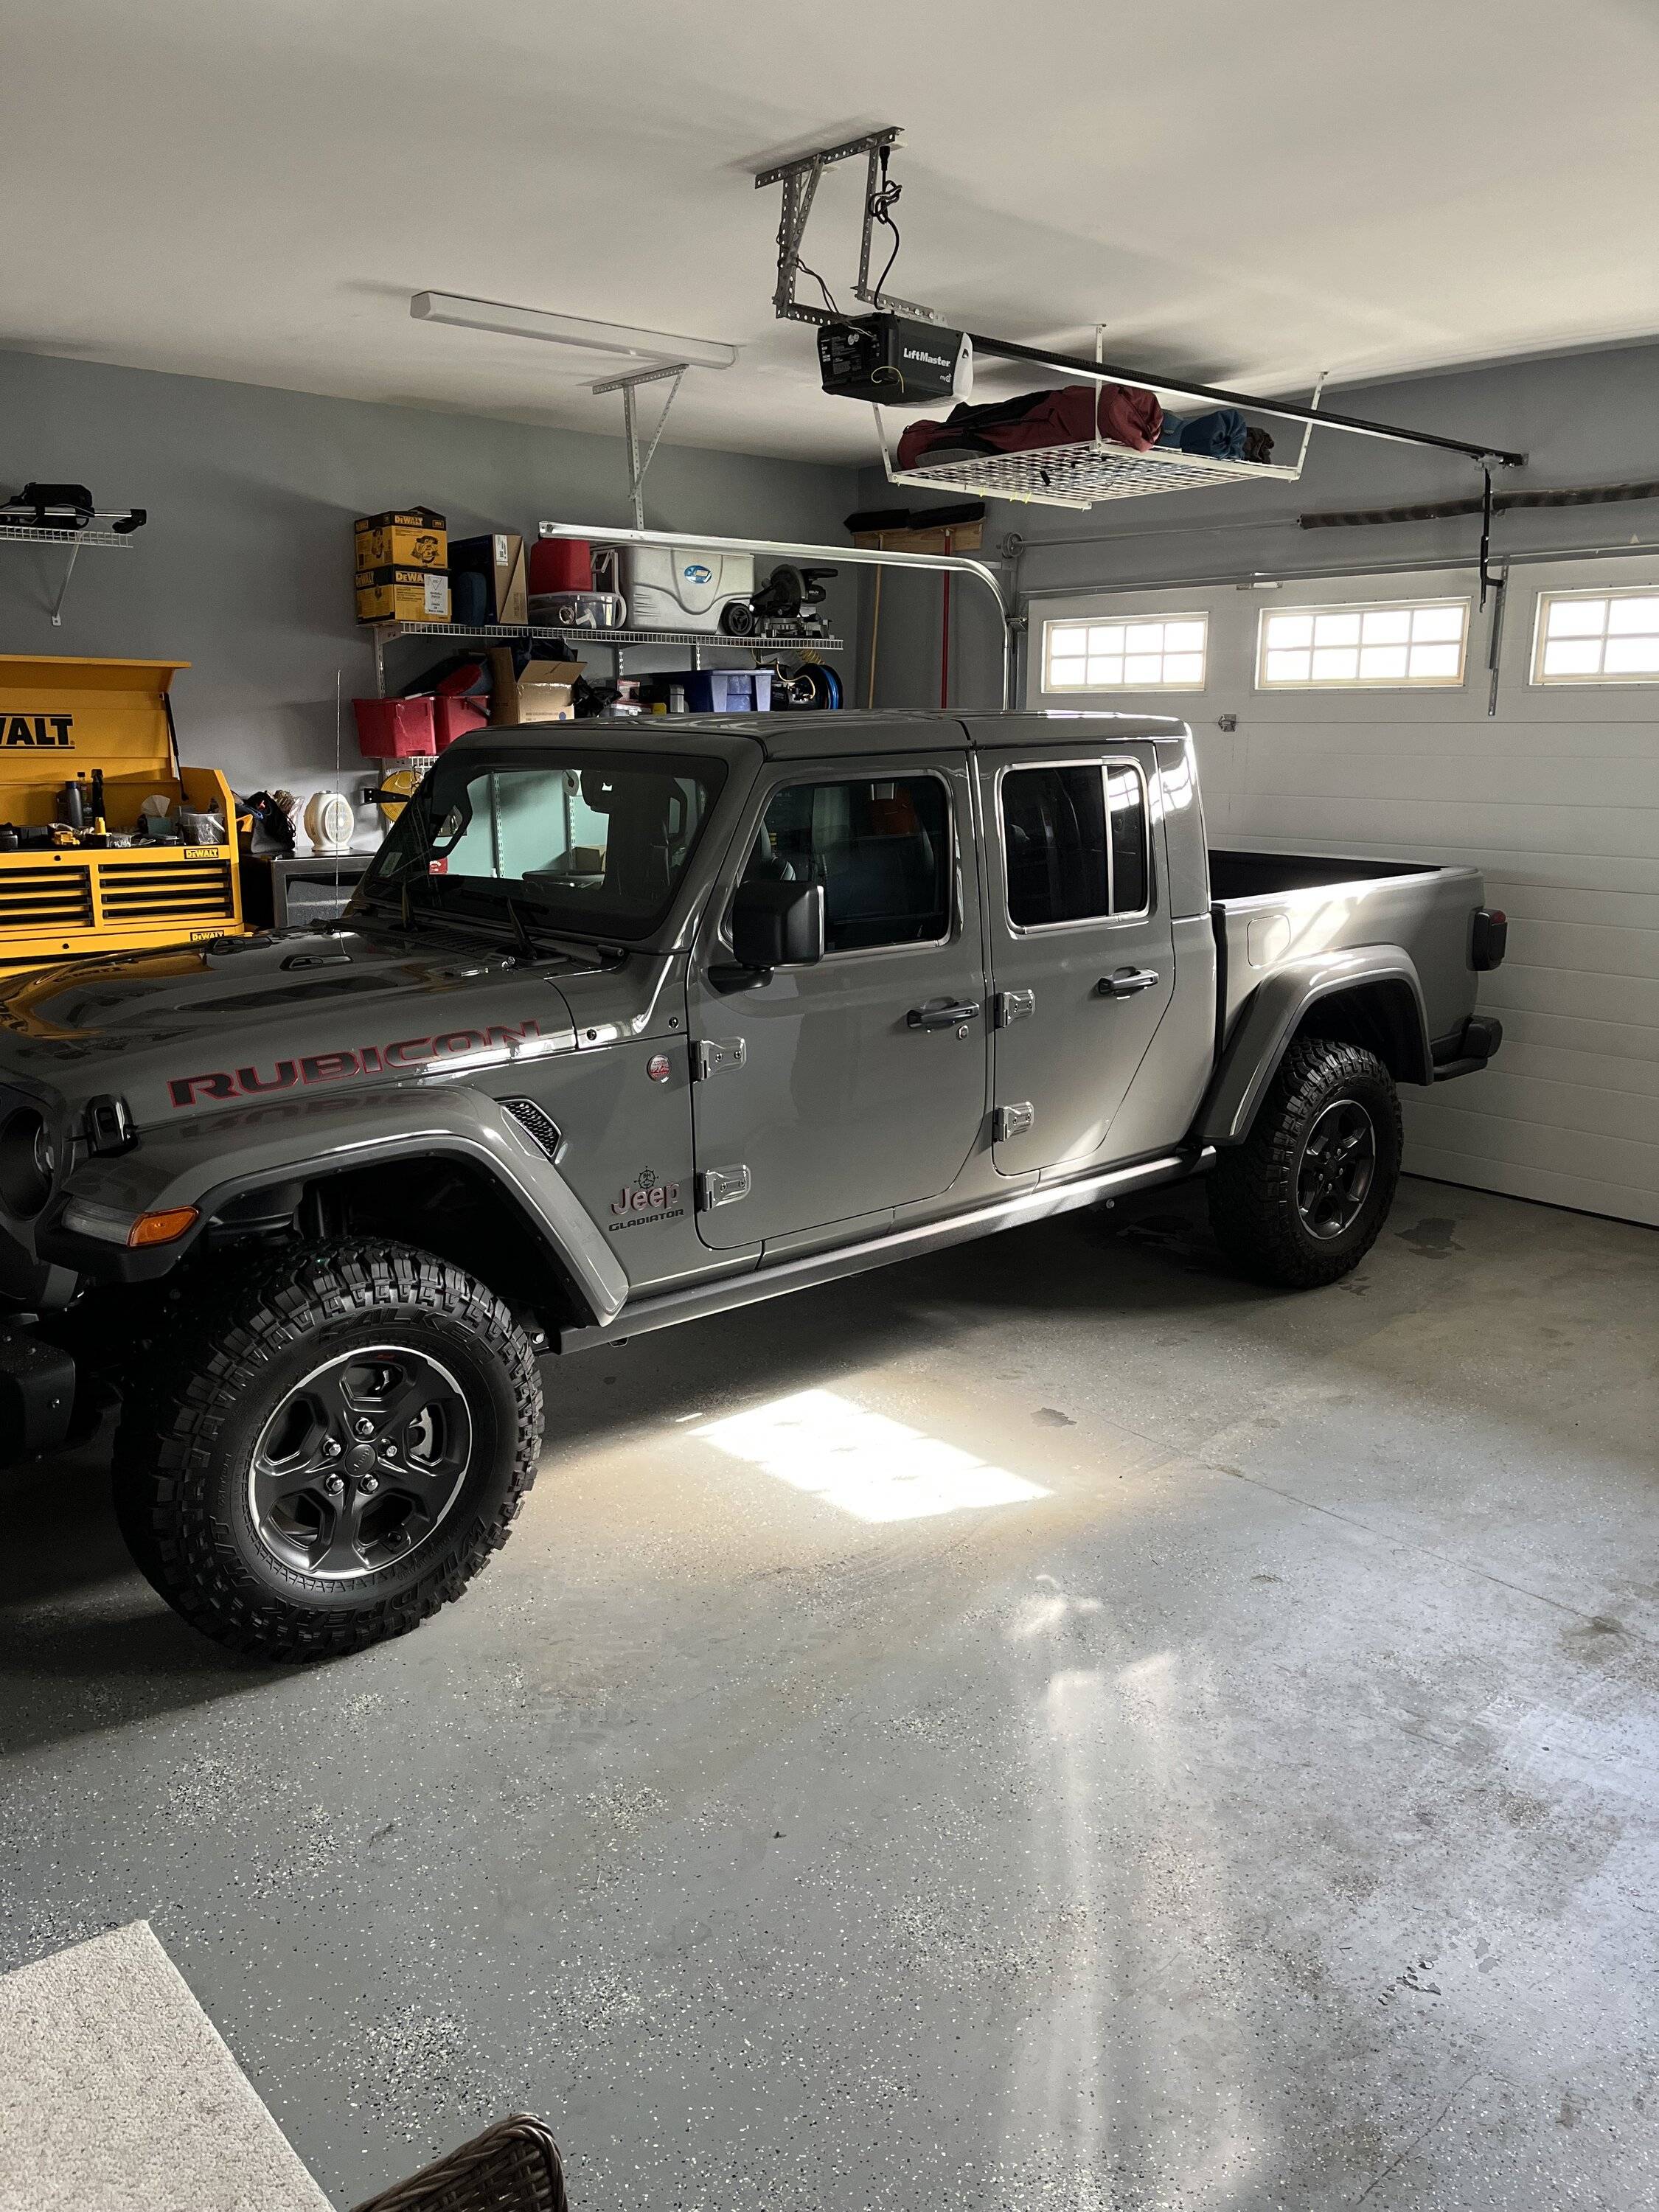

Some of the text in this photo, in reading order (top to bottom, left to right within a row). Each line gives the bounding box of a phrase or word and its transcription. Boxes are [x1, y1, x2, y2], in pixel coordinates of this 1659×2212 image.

[903, 347, 951, 367] LiftMaster
[396, 571, 425, 582] DEWA
[167, 1020, 540, 1107] RUBICON
[611, 1183, 680, 1215] Jeep
[608, 1208, 685, 1231] GLADIATOR
